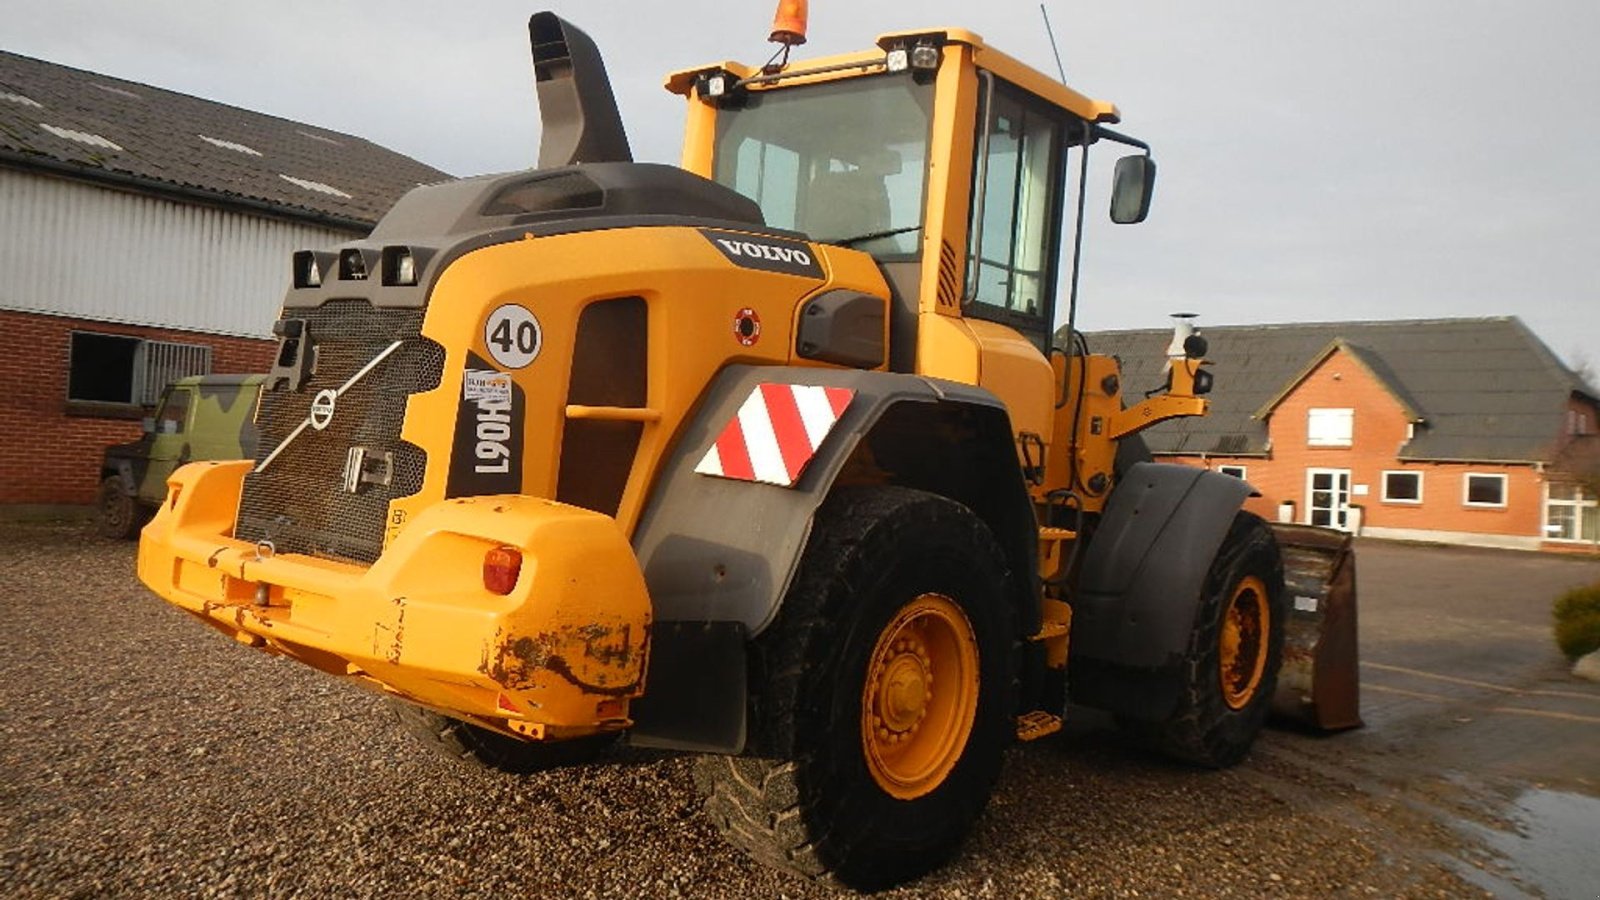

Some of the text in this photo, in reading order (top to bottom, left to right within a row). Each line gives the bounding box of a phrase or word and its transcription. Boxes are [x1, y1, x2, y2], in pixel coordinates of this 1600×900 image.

[717, 238, 811, 266] VOLVO
[491, 318, 537, 354] 40
[474, 402, 512, 473] L90H
